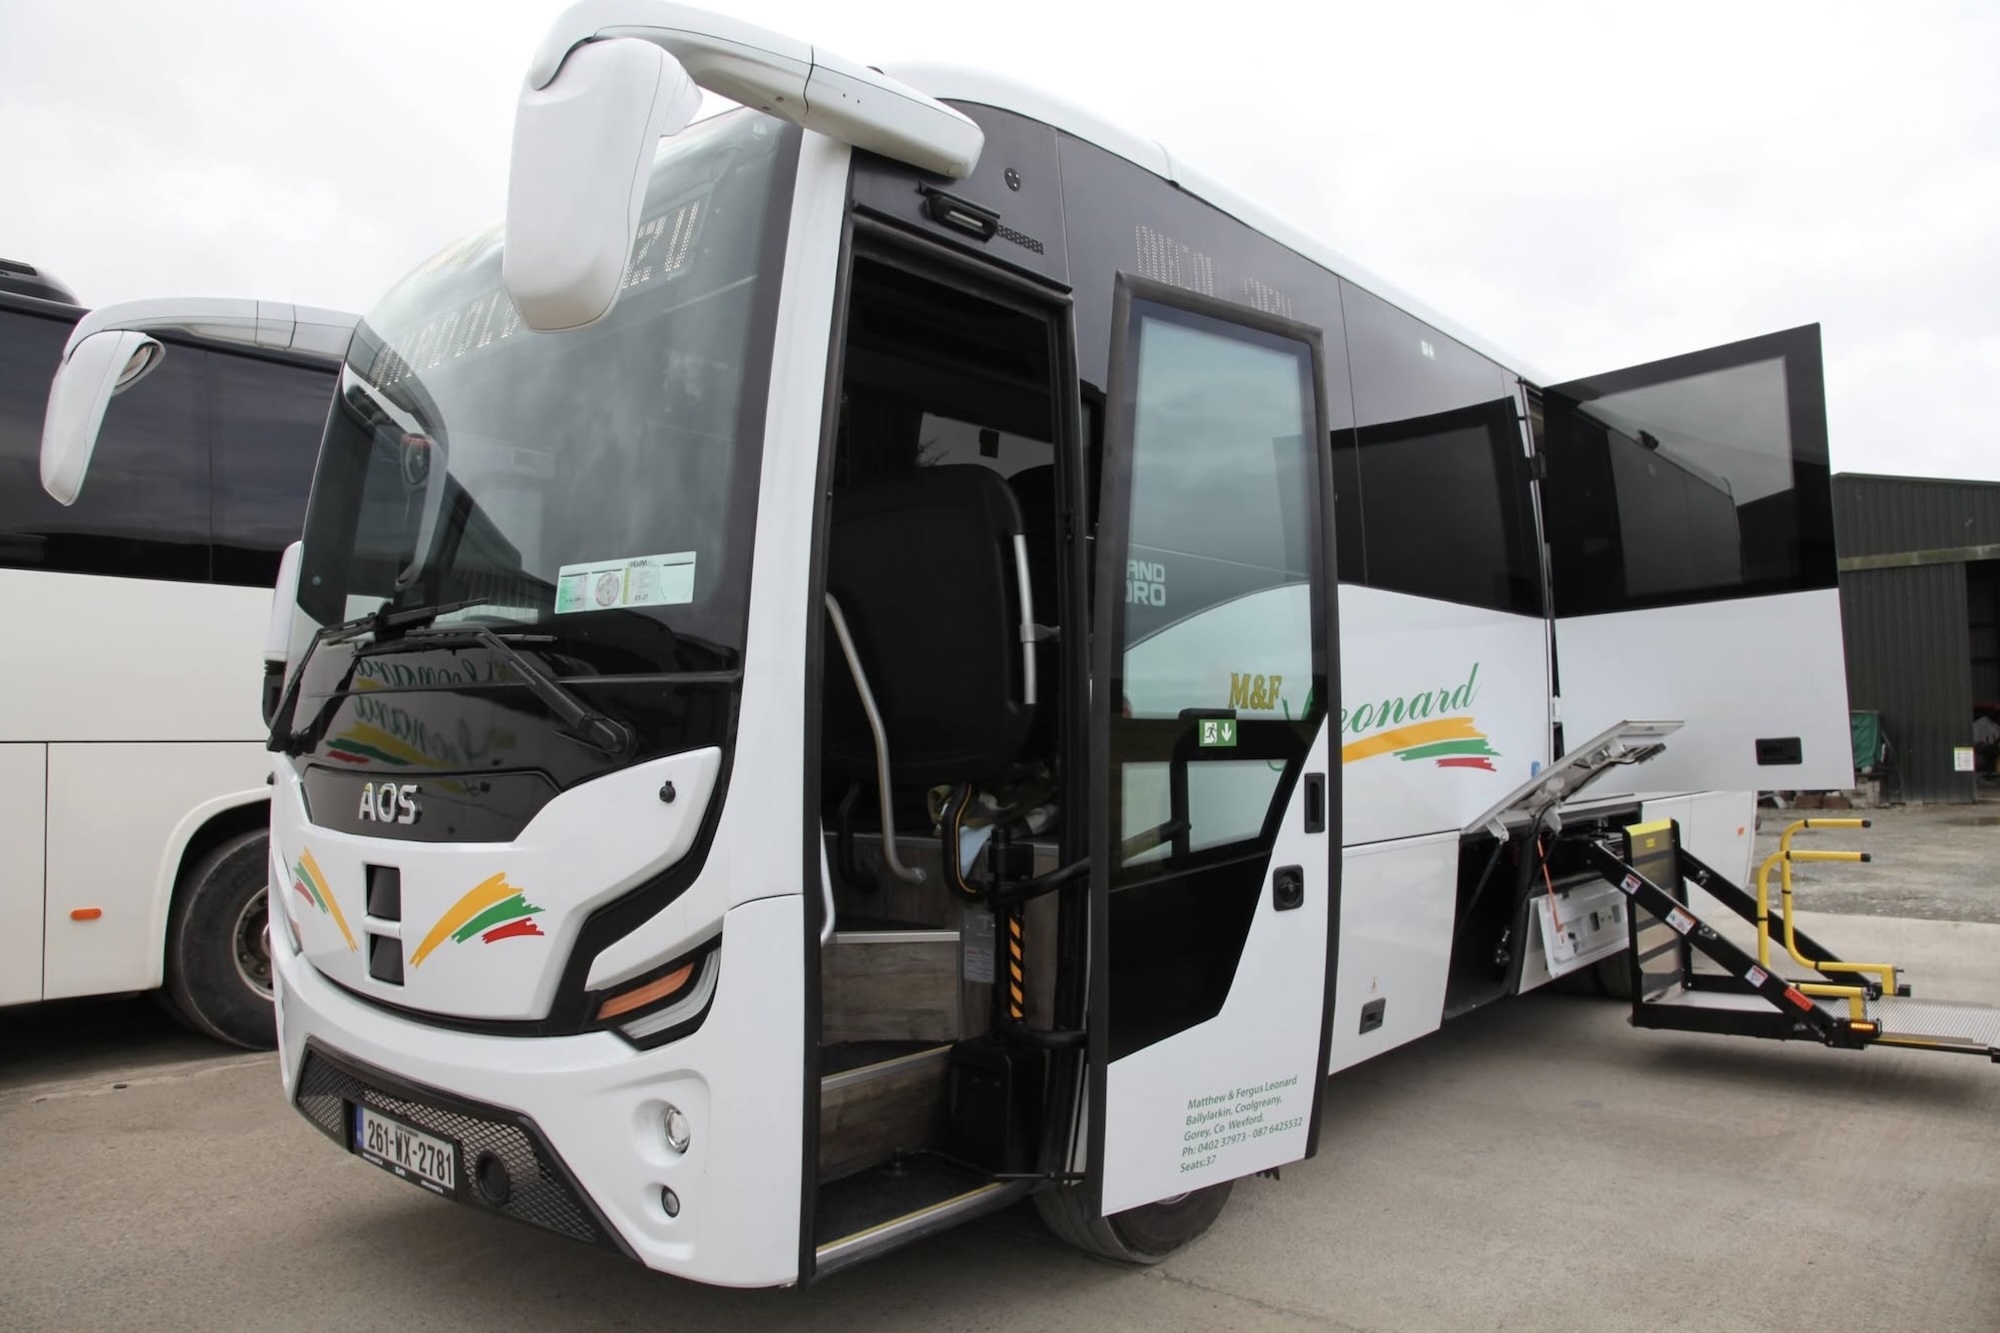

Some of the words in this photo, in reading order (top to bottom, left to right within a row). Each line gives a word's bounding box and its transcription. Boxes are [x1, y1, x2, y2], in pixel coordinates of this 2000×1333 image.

[1228, 672, 1282, 711] M&F
[1282, 662, 1480, 736] eonard
[358, 782, 422, 825] AOS
[1188, 1094, 1226, 1110] Matthew
[1227, 1091, 1235, 1101] &
[1236, 1084, 1263, 1098] Fergus
[1265, 1075, 1298, 1092] Leonard
[1182, 1145, 1197, 1157] Ph:
[1198, 1139, 1219, 1153] 0402
[1221, 1132, 1246, 1148] 37973
[1253, 1125, 1268, 1139] 087
[1269, 1117, 1303, 1135] 6425532
[1214, 1123, 1225, 1134] Co
[368, 1119, 453, 1185] 261-WX-2781
[1180, 1155, 1217, 1173] Seats:37
